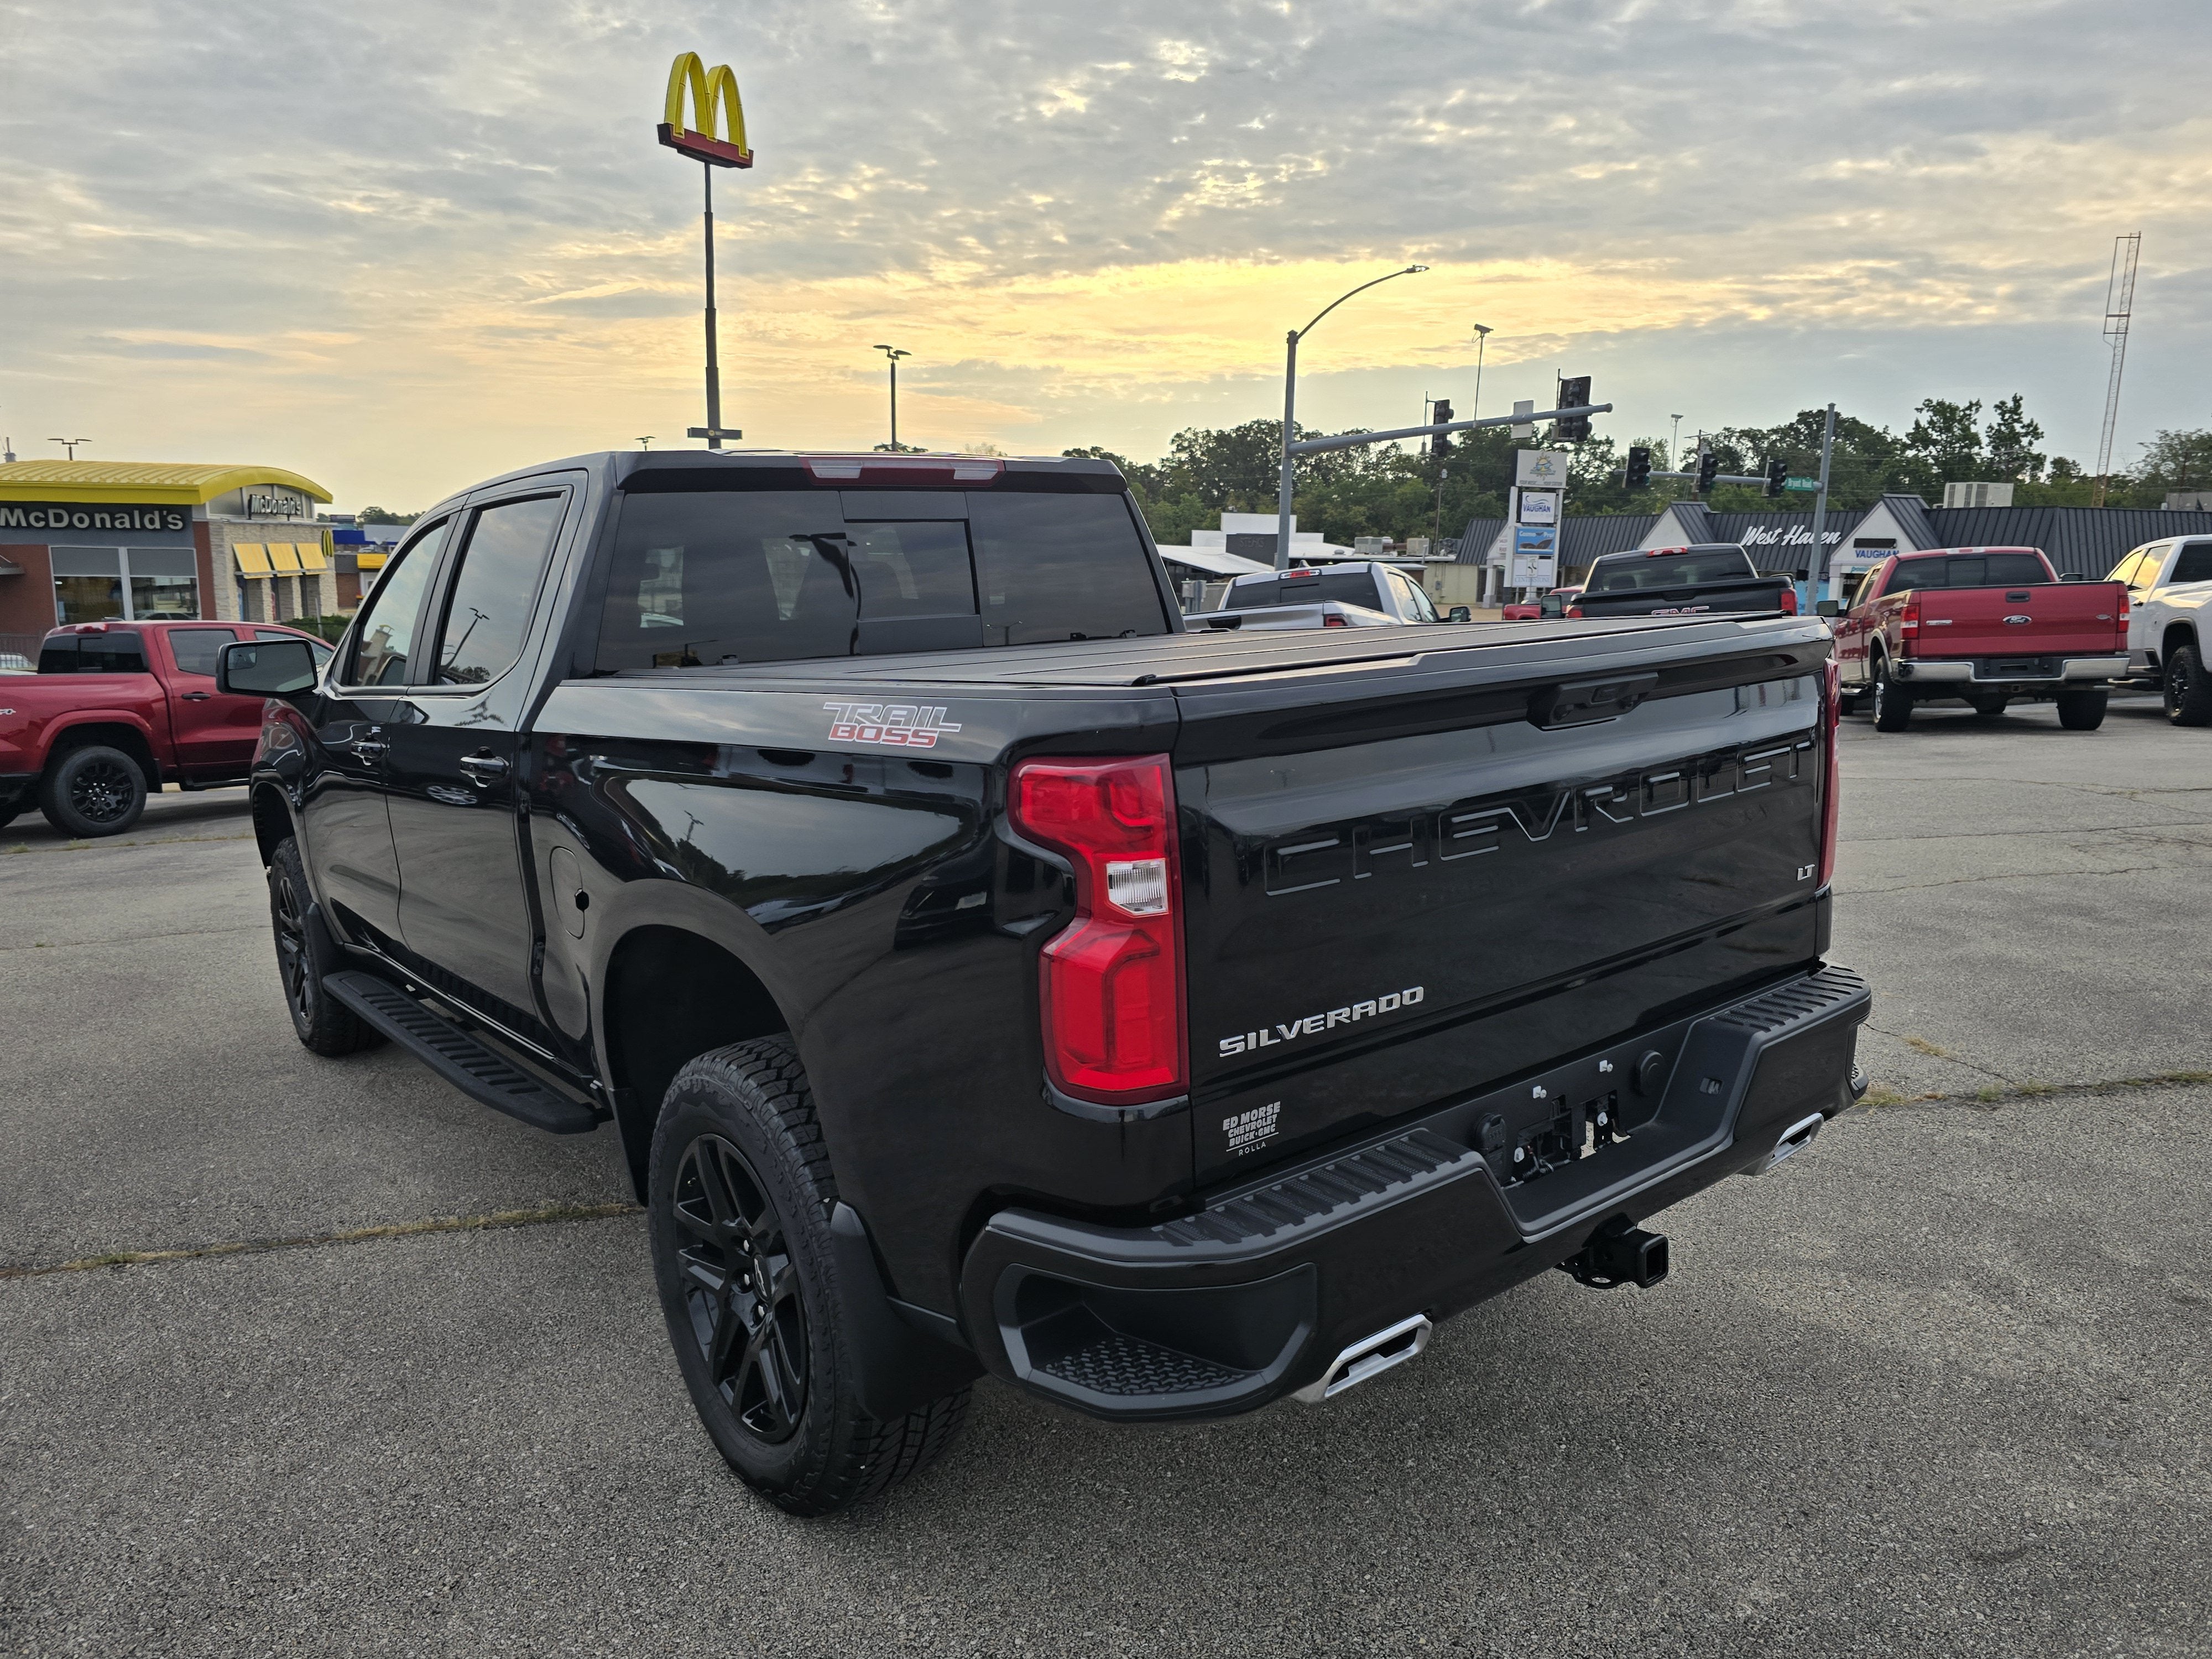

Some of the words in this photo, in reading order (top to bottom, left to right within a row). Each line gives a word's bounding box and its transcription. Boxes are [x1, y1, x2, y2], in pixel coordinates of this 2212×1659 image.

[251, 495, 301, 514] McDonald's
[1523, 503, 1551, 512] VAUGHAN
[0, 508, 184, 529] McDonald's
[1740, 526, 1783, 546] West
[1855, 550, 1900, 559] VAUGHAN
[823, 702, 962, 732] TRAIL
[828, 723, 940, 748] BOSS
[1265, 742, 1811, 896] CHEVROLET
[1797, 864, 1815, 881] LT
[1219, 986, 1423, 1057] SILVERADO
[1223, 1116, 1238, 1131] ED
[1240, 1101, 1280, 1125] MORSE
[1228, 1114, 1277, 1138] CHEVROLET
[1239, 1141, 1266, 1156] ROLLA
